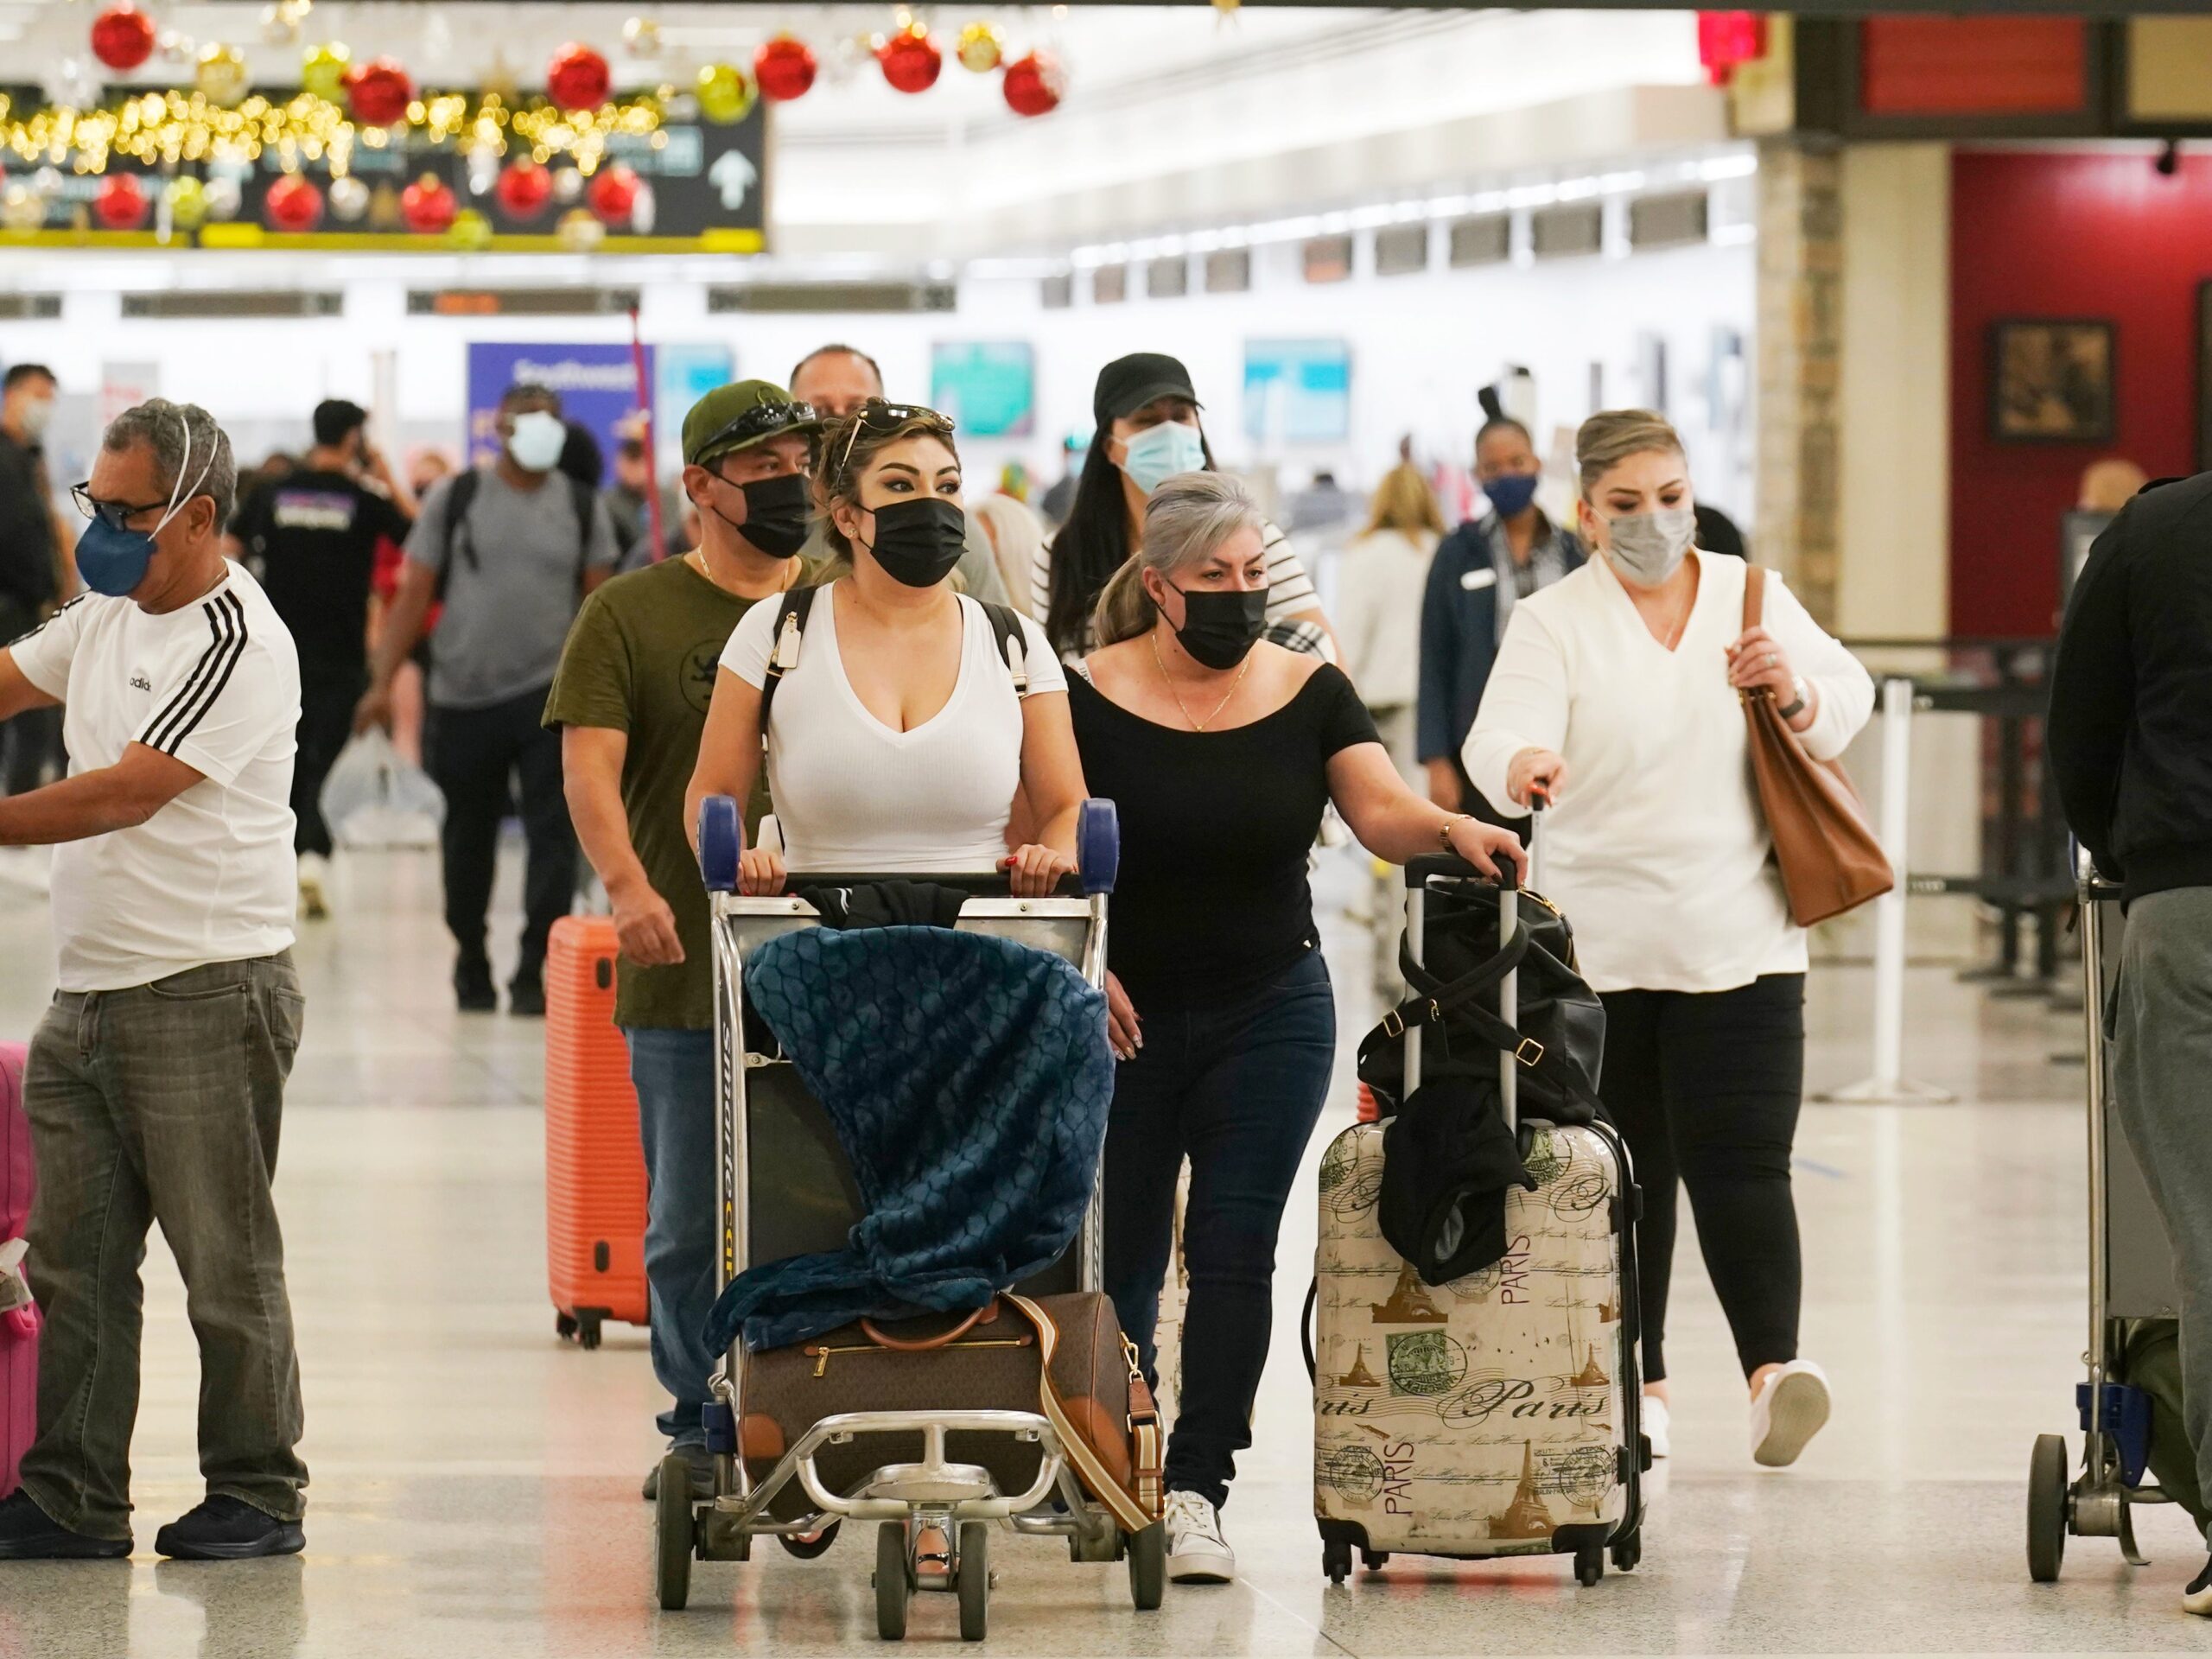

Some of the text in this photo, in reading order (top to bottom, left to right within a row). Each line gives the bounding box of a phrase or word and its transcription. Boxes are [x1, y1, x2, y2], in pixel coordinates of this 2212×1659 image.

[1501, 1236, 1530, 1306] PARIS
[1436, 1376, 1606, 1430] Paris
[1383, 1442, 1415, 1515] PARIS
